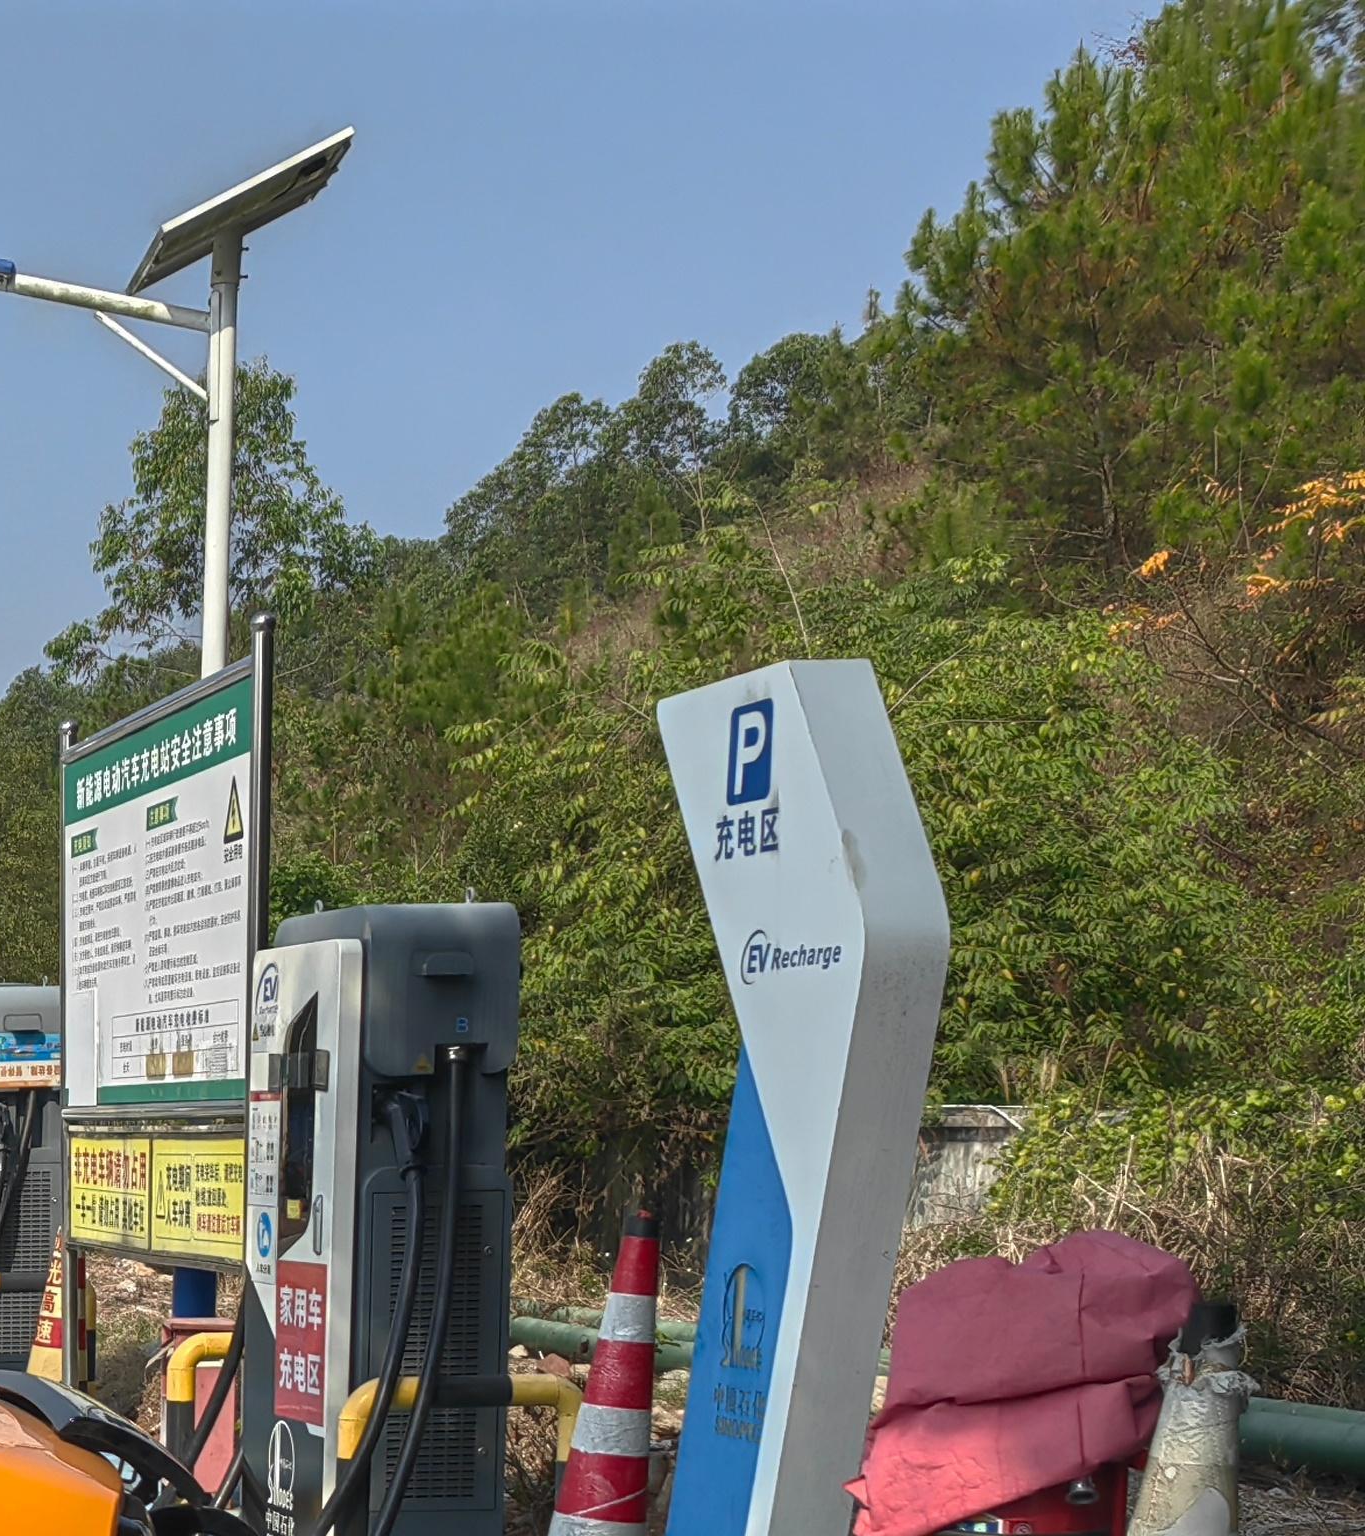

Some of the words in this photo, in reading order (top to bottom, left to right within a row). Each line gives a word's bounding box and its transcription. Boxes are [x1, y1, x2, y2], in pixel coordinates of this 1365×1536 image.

[76, 707, 237, 810] 新能源电动汽车充电站安全注意事项
[733, 709, 767, 796] P
[715, 806, 780, 861] 充电区
[746, 943, 772, 974] EV
[771, 943, 842, 972] Recharge
[263, 974, 278, 1002] EV
[74, 1146, 147, 1191] 非充电车辆请勿占用
[279, 1284, 322, 1331] 家用车
[279, 1347, 321, 1395] 充电区
